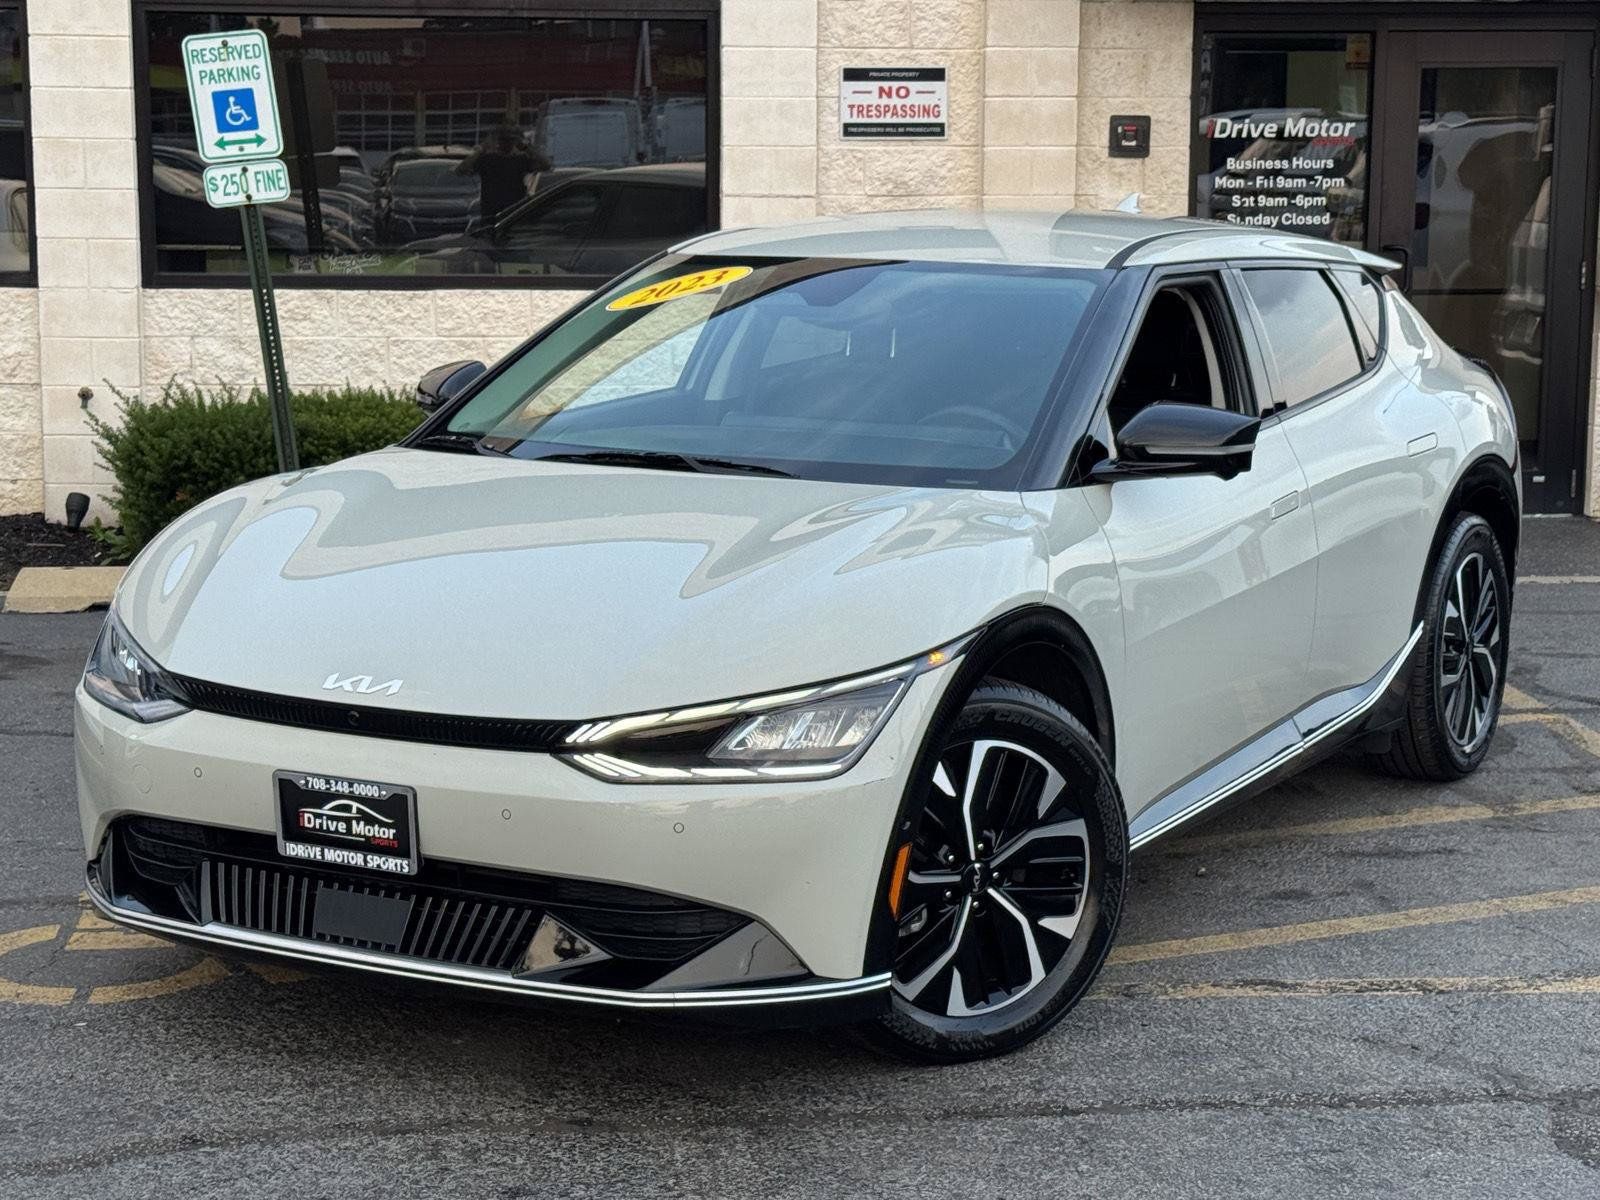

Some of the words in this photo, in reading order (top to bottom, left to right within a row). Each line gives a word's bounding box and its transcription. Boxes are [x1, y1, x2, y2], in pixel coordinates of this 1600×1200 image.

[191, 44, 261, 64] RESERVED
[199, 65, 261, 85] PARKING
[878, 86, 910, 99] NO
[848, 104, 941, 118] TRESPASSING
[1283, 117, 1356, 138] Motor
[1226, 158, 1289, 169] Business
[1292, 157, 1334, 169] Hours
[254, 169, 286, 193] FINE
[1214, 176, 1244, 188] Mon
[1256, 176, 1274, 188] Fri
[1276, 176, 1307, 188] 9am
[1231, 194, 1255, 207] Sat
[1257, 195, 1288, 207] 9am
[1281, 212, 1331, 225] Closed
[628, 270, 729, 307] 2023
[322, 672, 404, 697] KIA
[306, 777, 379, 797] 708-348-0000
[298, 812, 347, 833] iDrive
[352, 820, 396, 840] Motor
[370, 837, 398, 848] SPORTS
[324, 848, 365, 866] MOTOR
[367, 854, 410, 873] SPORTS
